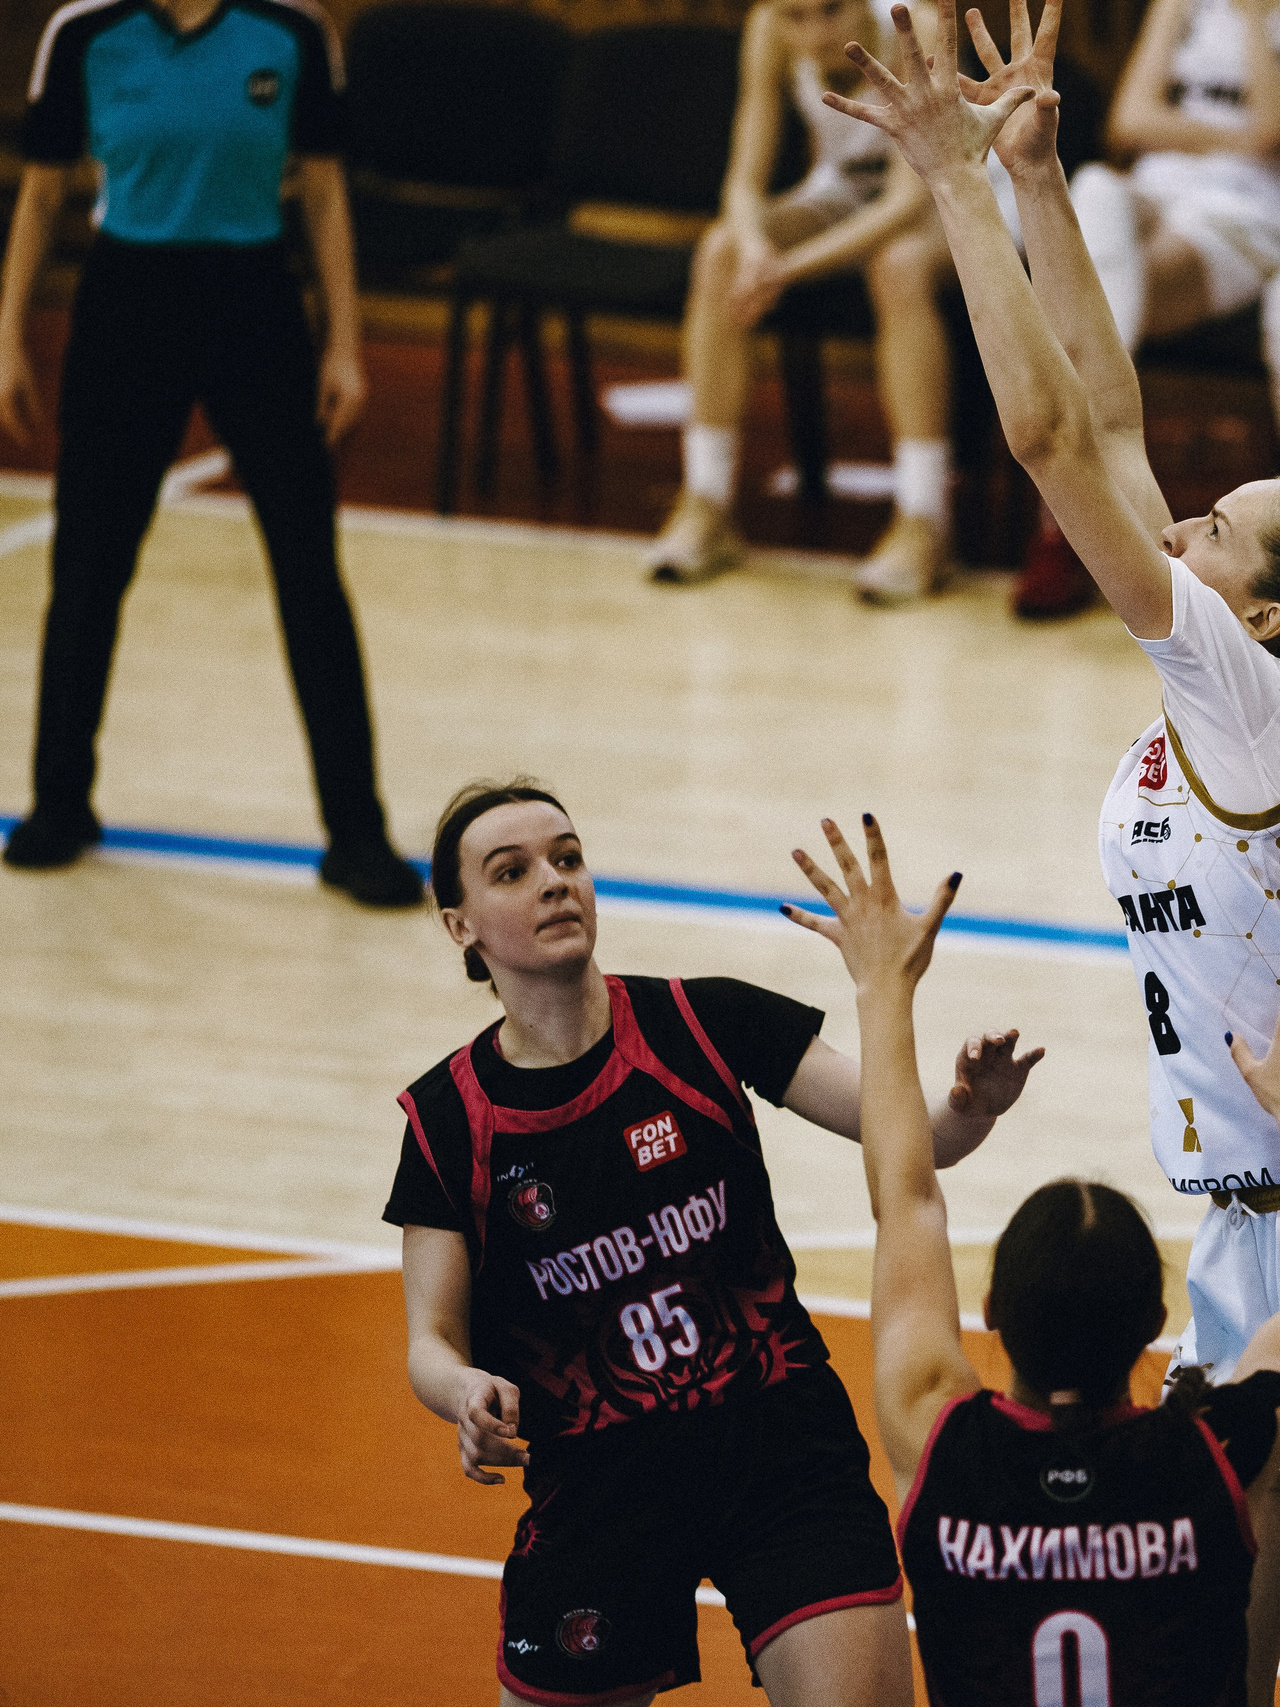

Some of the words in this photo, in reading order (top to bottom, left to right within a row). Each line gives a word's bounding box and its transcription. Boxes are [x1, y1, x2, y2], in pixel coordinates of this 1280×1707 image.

[1144, 971, 1182, 1056] 8
[630, 1115, 673, 1149] FON
[637, 1132, 678, 1166] BET
[526, 1179, 728, 1300] РОСТОВ-ЮФУ
[618, 1282, 701, 1372] 85
[937, 1514, 1199, 1580] НАХИМОВА
[1030, 1608, 1111, 1707] 0
